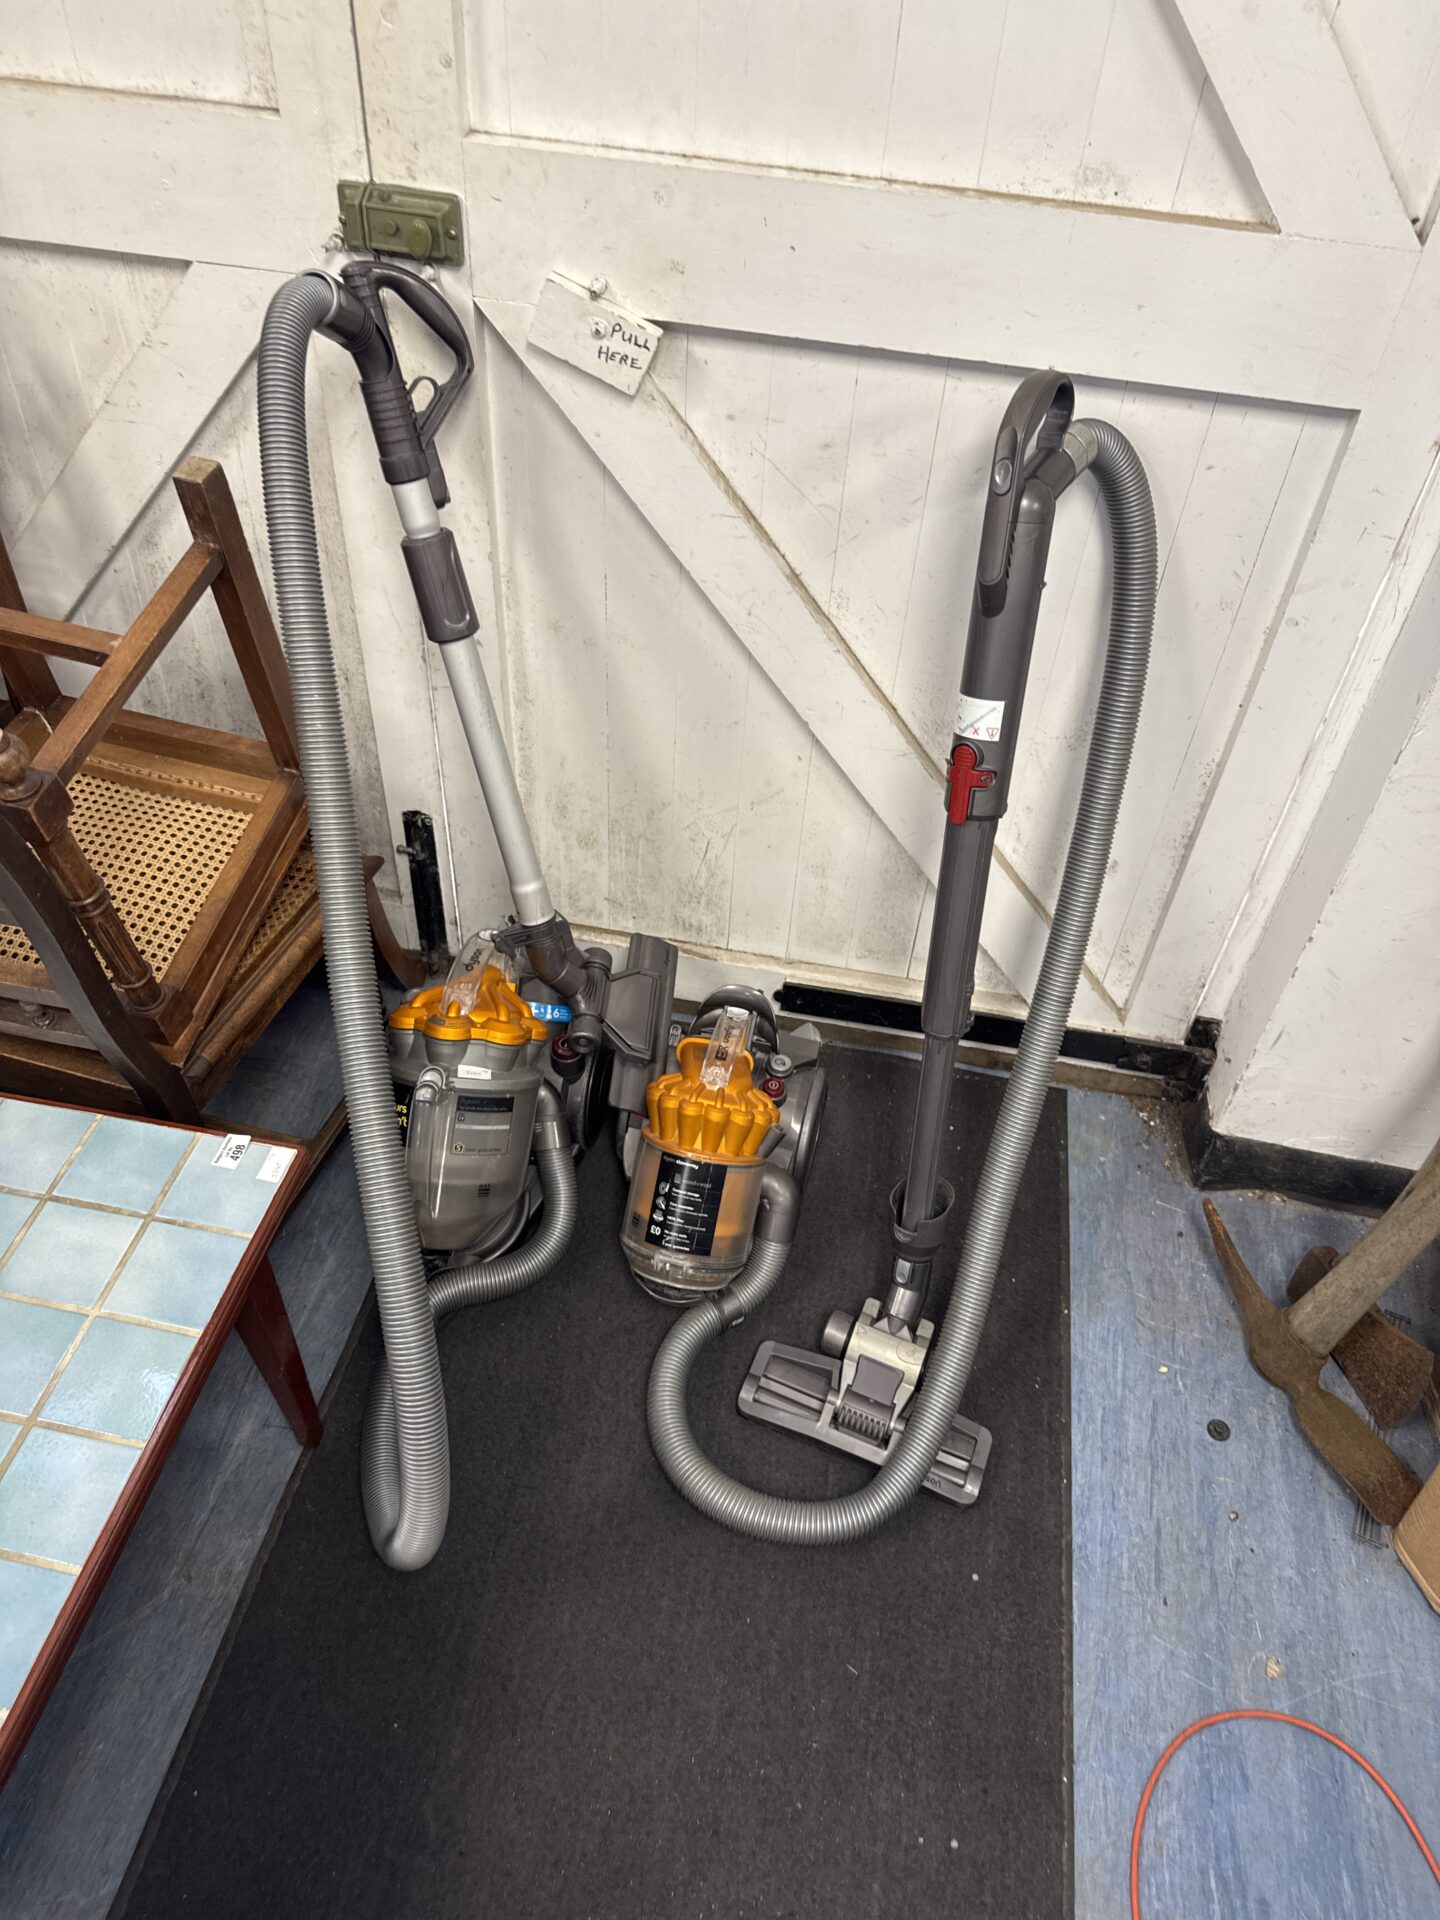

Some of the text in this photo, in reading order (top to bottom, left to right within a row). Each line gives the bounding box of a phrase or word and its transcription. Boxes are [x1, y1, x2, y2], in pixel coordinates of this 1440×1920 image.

[610, 323, 650, 352] PULL
[597, 346, 642, 370] HERE
[463, 948, 484, 972] dyson
[230, 1144, 246, 1161] 498
[650, 1224, 661, 1236] £0
